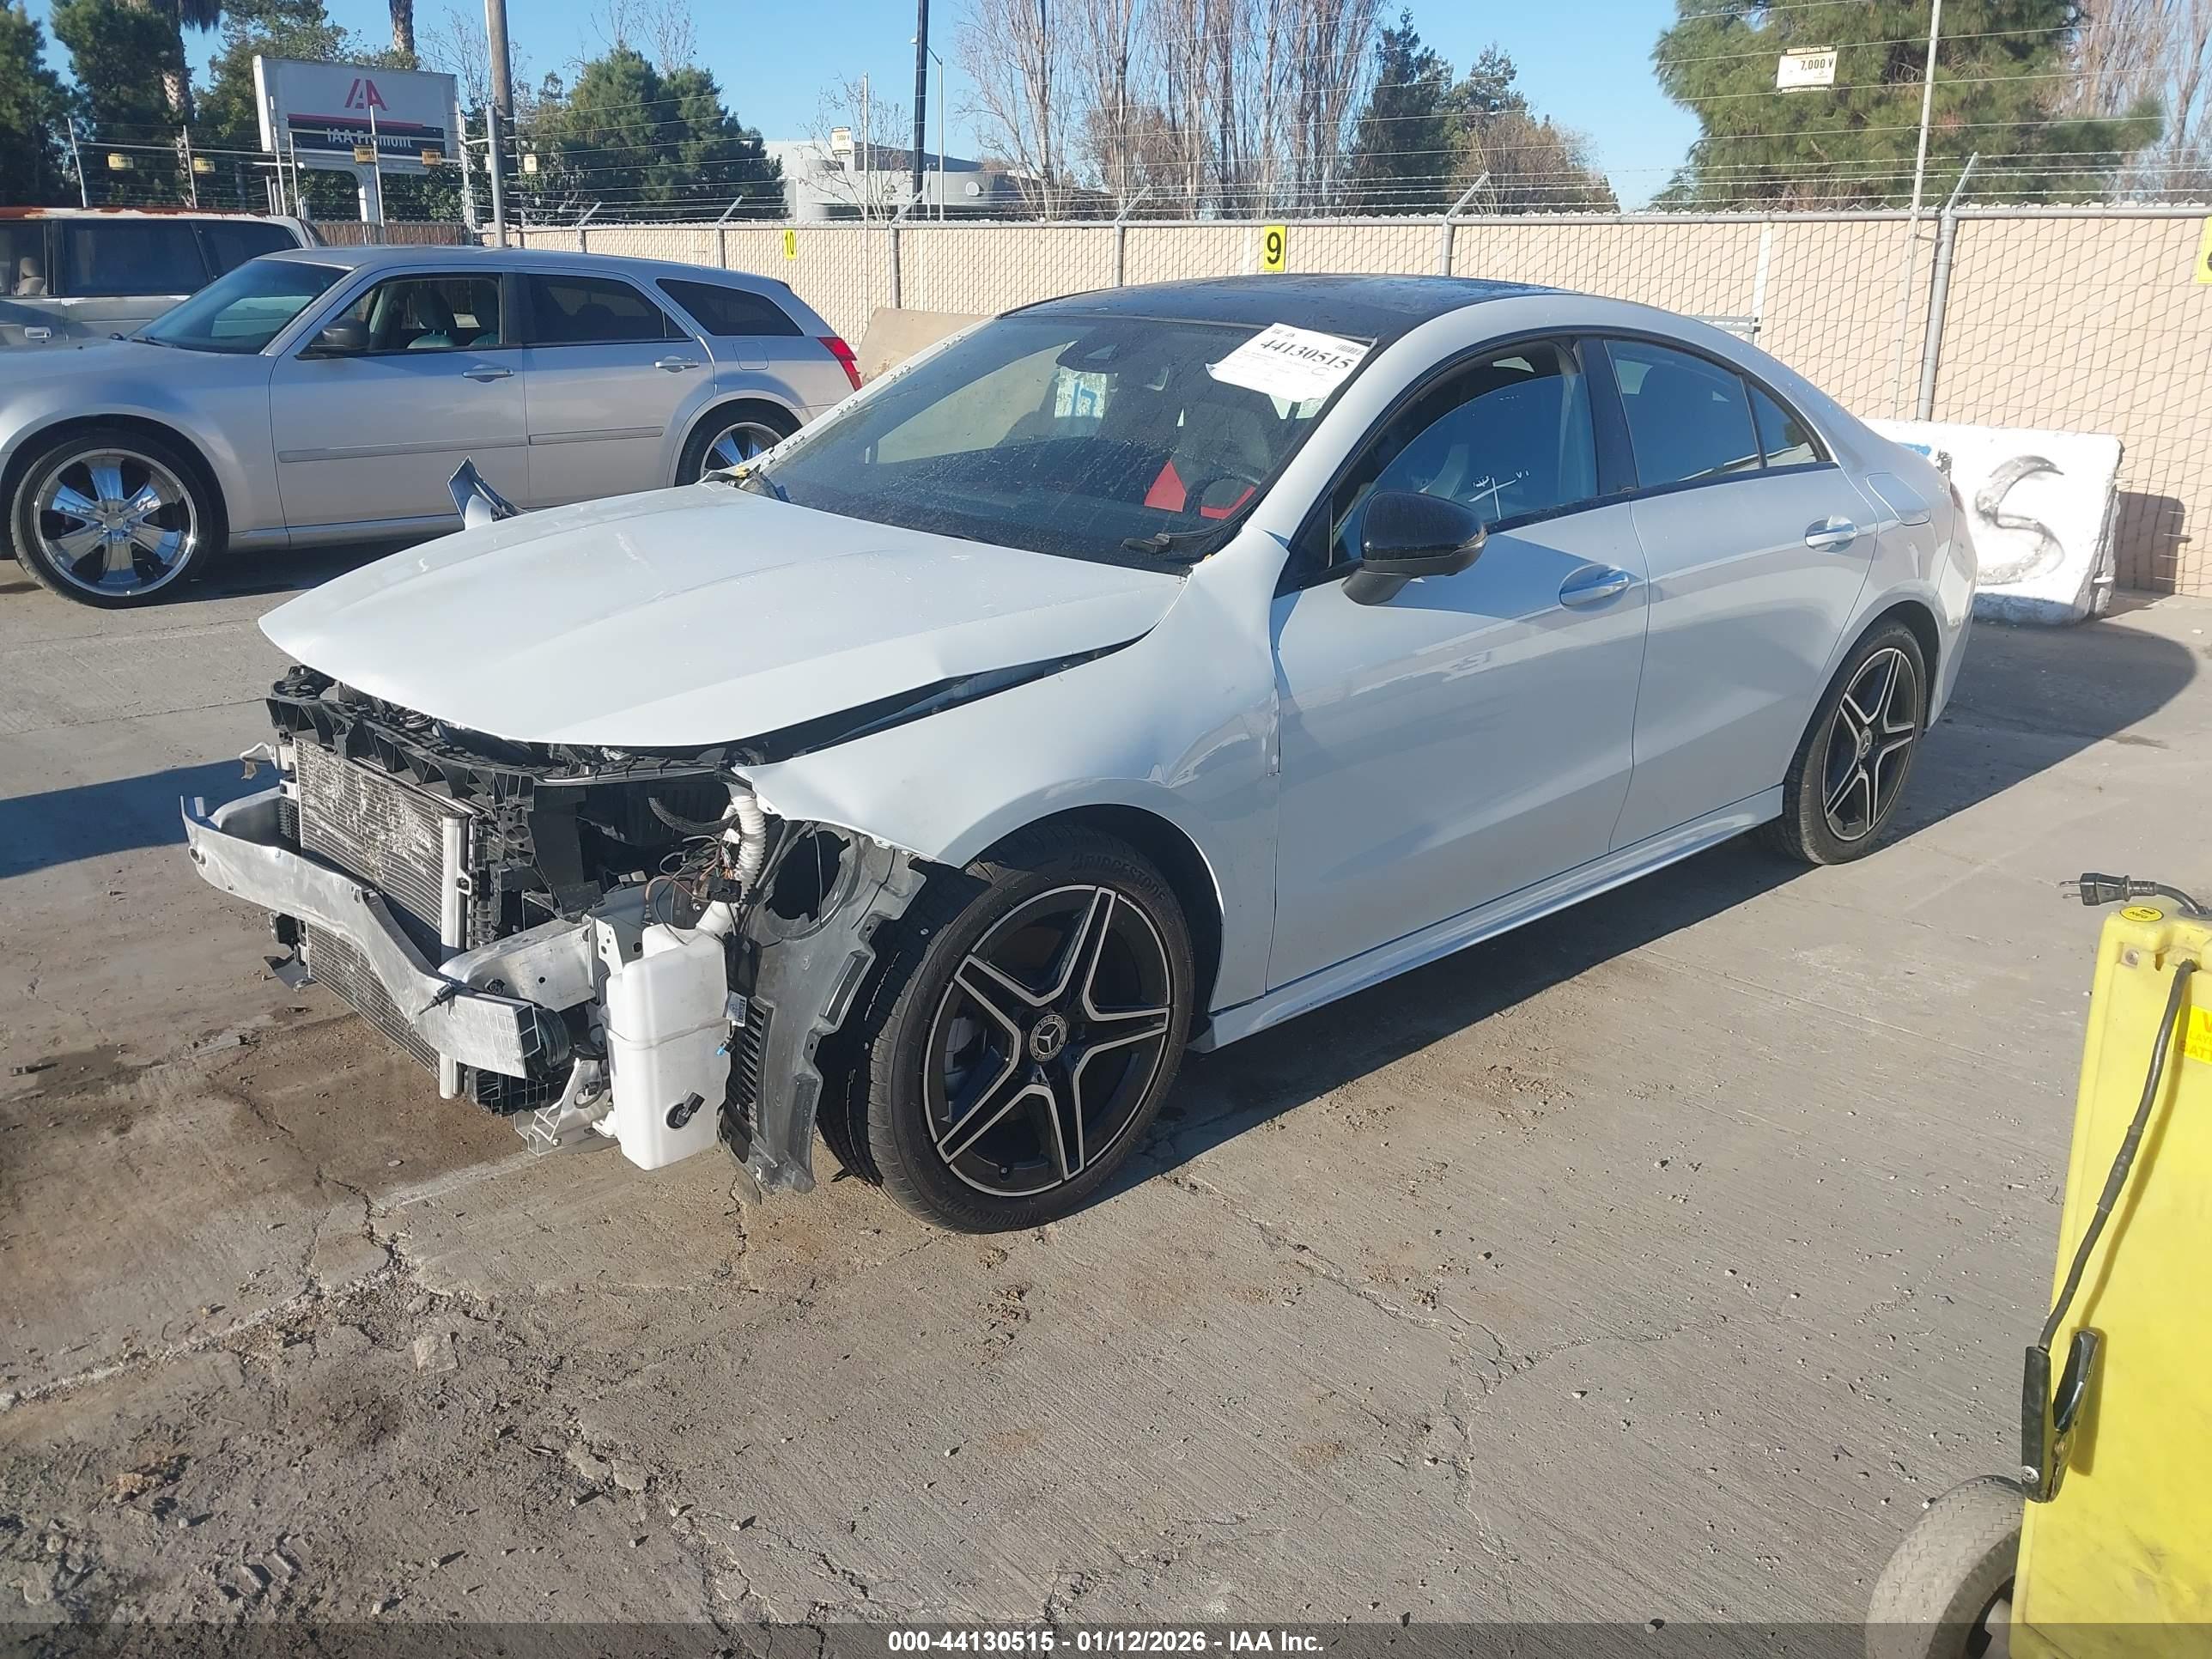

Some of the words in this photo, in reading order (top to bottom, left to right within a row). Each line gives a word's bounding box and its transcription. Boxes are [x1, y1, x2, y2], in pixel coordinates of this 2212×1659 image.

[1800, 58, 1826, 71] 7,000
[1828, 57, 1835, 69] V
[326, 127, 354, 143] IAA
[784, 230, 794, 255] 10
[1267, 231, 1282, 265] 9
[1260, 338, 1356, 369] 44130515
